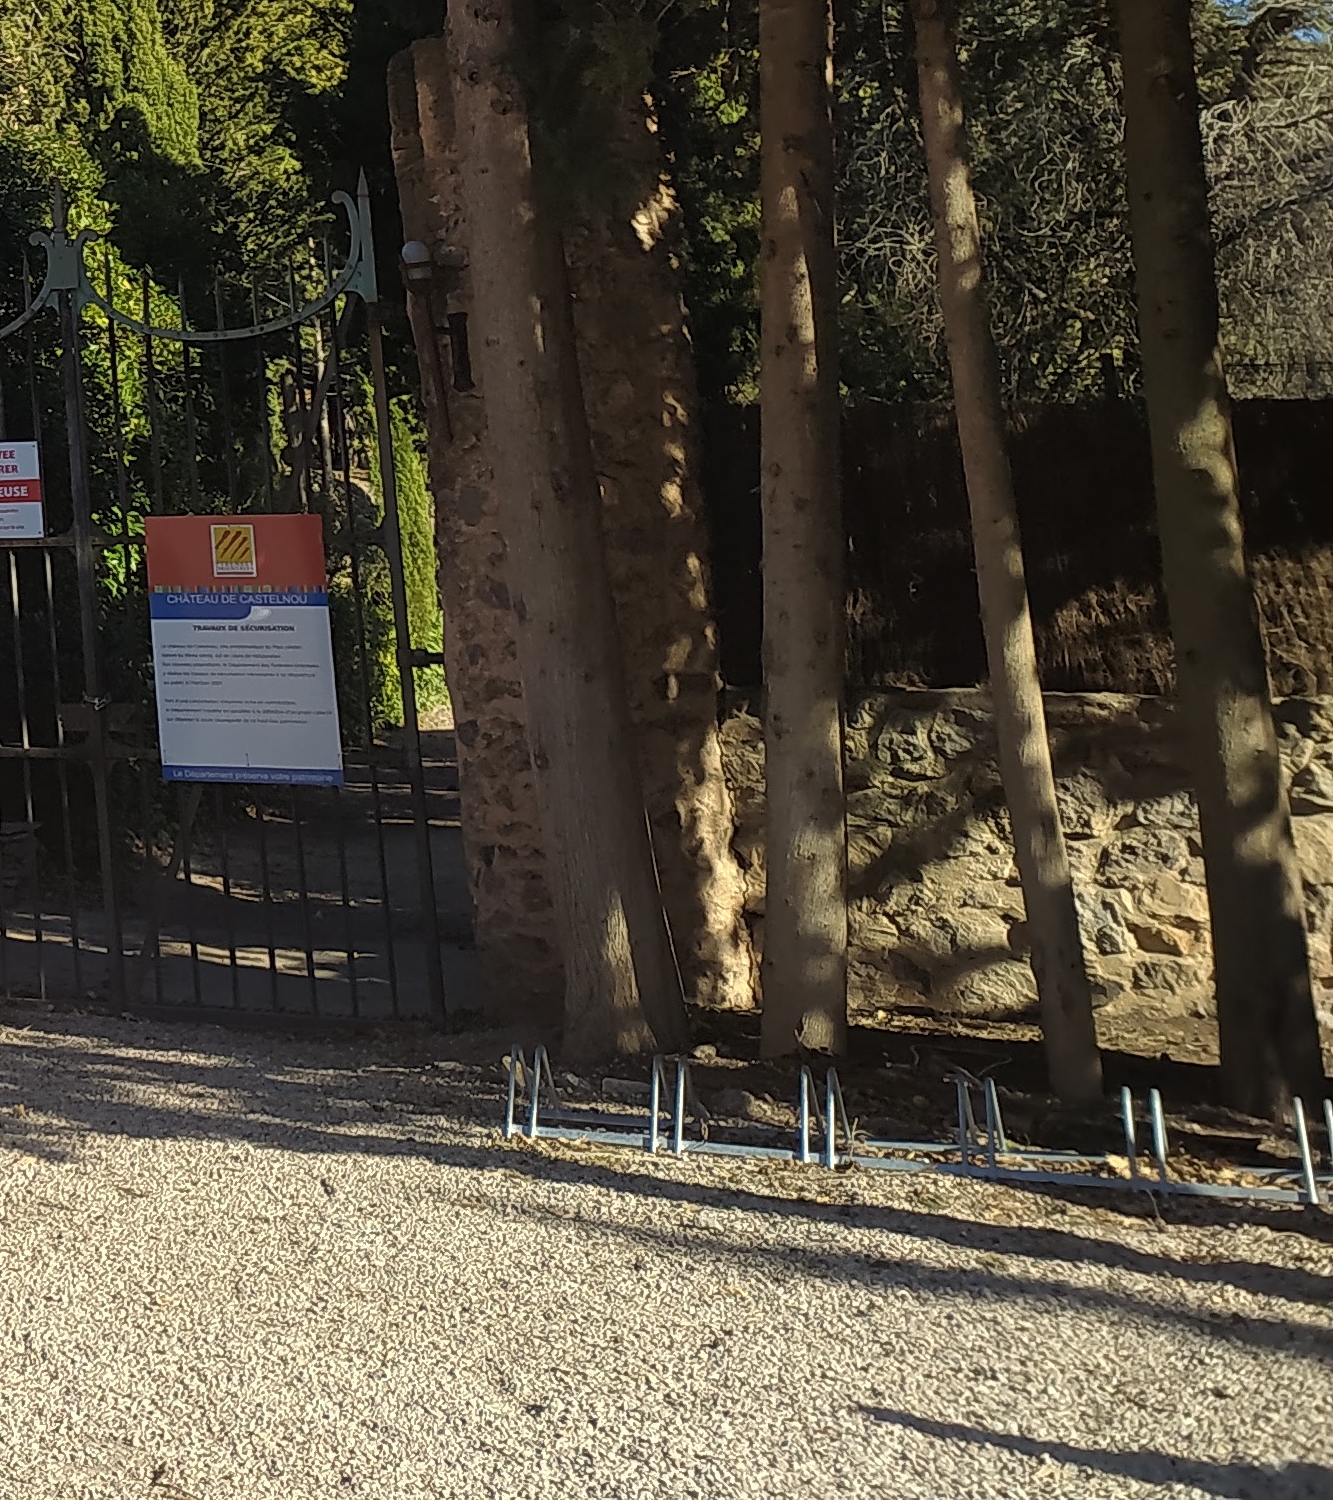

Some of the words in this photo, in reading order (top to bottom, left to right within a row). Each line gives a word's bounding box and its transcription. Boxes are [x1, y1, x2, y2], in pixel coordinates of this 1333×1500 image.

[166, 594, 219, 604] CHÂTEAU
[221, 594, 236, 604] DE
[239, 594, 308, 604] CASTELNOU
[173, 770, 183, 778] Le
